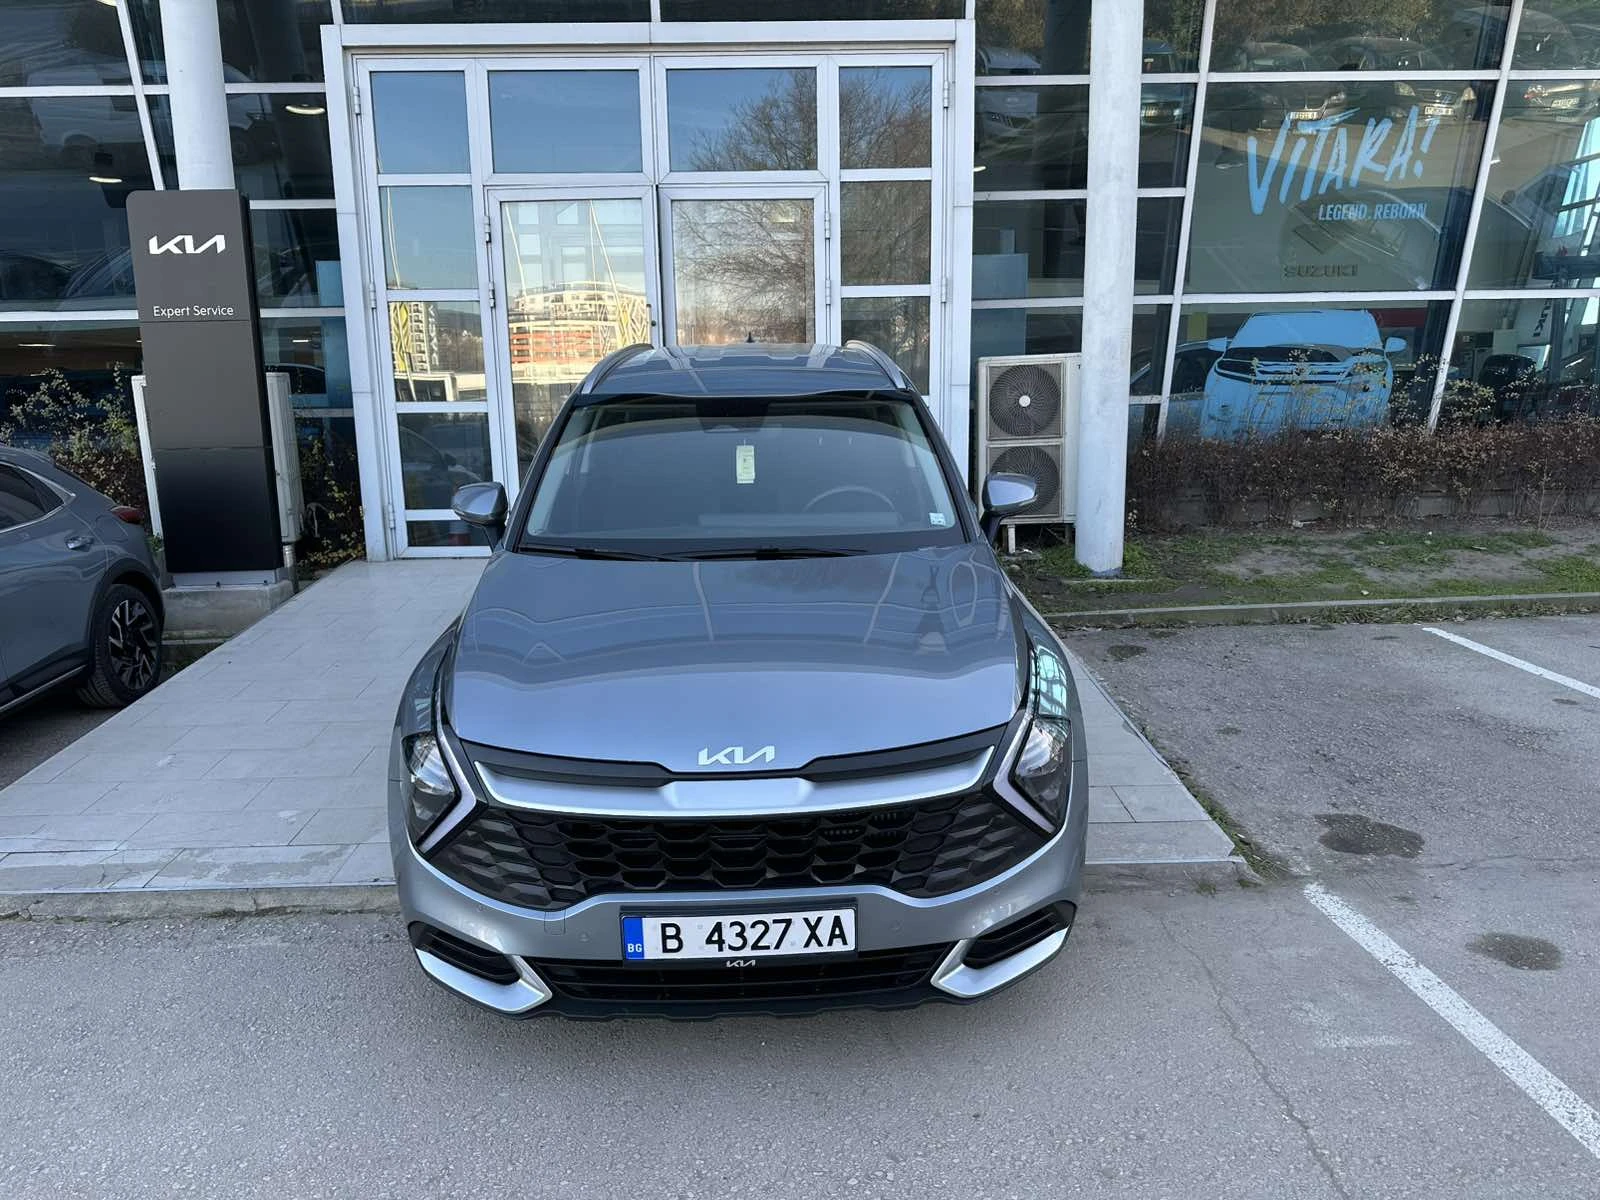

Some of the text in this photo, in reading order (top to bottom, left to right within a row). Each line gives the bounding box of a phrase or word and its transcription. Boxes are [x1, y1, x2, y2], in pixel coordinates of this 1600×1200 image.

[1247, 94, 1450, 215] VITARA!
[1374, 203, 1427, 220] REBORN
[148, 234, 226, 255] KIA
[1283, 263, 1359, 278] SUZUKI
[153, 305, 235, 319] Expert Service
[698, 745, 776, 766] KIA
[660, 915, 849, 954] B 4327 XA
[627, 943, 642, 953] BG
[726, 959, 756, 968] KIA
